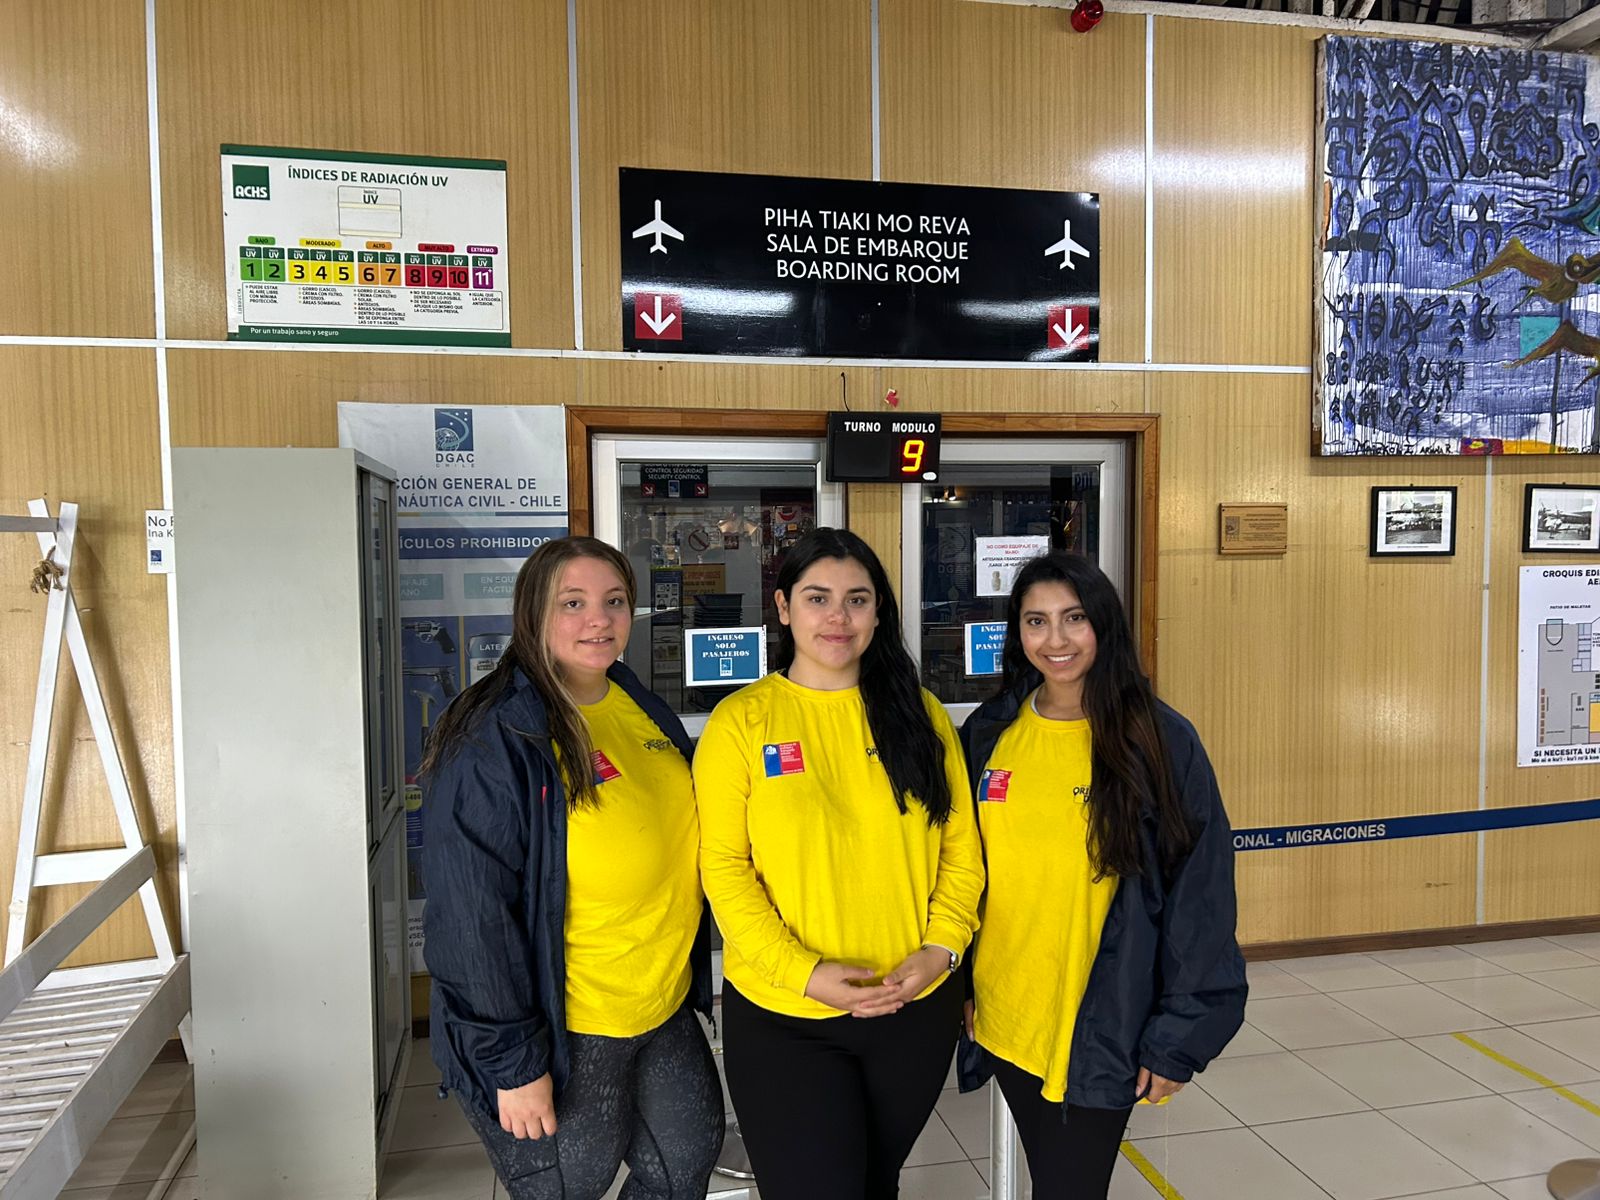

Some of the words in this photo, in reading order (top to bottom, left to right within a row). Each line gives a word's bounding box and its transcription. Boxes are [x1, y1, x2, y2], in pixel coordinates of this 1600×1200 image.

[288, 165, 338, 181] ÍNDICES
[342, 171, 357, 181] DE
[361, 172, 428, 186] RADIACIÓN
[432, 176, 448, 186] UV
[235, 185, 268, 198] ACHS
[363, 195, 378, 204] UV
[765, 208, 813, 228] PIHA
[819, 210, 869, 230] TIAKI
[878, 213, 912, 232] MO
[920, 216, 970, 235] REVA
[767, 233, 818, 253] SALA
[825, 236, 850, 254] DE
[857, 238, 968, 262] EMBARQUE
[247, 263, 254, 277] 1
[269, 264, 280, 278] 2
[294, 265, 305, 279] 3
[316, 266, 327, 280] 4
[339, 267, 349, 280] 5
[363, 268, 375, 281] 6
[385, 269, 396, 282] 7
[410, 269, 421, 283] 8
[432, 270, 442, 284] 9
[450, 271, 468, 284] 10
[777, 260, 888, 281] BOARDING
[896, 264, 959, 284] ROOM
[844, 422, 881, 432] TURNO
[892, 422, 935, 434] MODULO
[436, 453, 474, 463] DGAC
[902, 440, 924, 472] 9
[443, 478, 512, 490] GENERAL
[518, 478, 536, 489] DE
[468, 495, 505, 507] CIVIL
[520, 495, 562, 507] CHILE
[148, 516, 167, 526] No
[148, 529, 163, 537] Ina
[1286, 824, 1386, 844] MIGRACIONES
